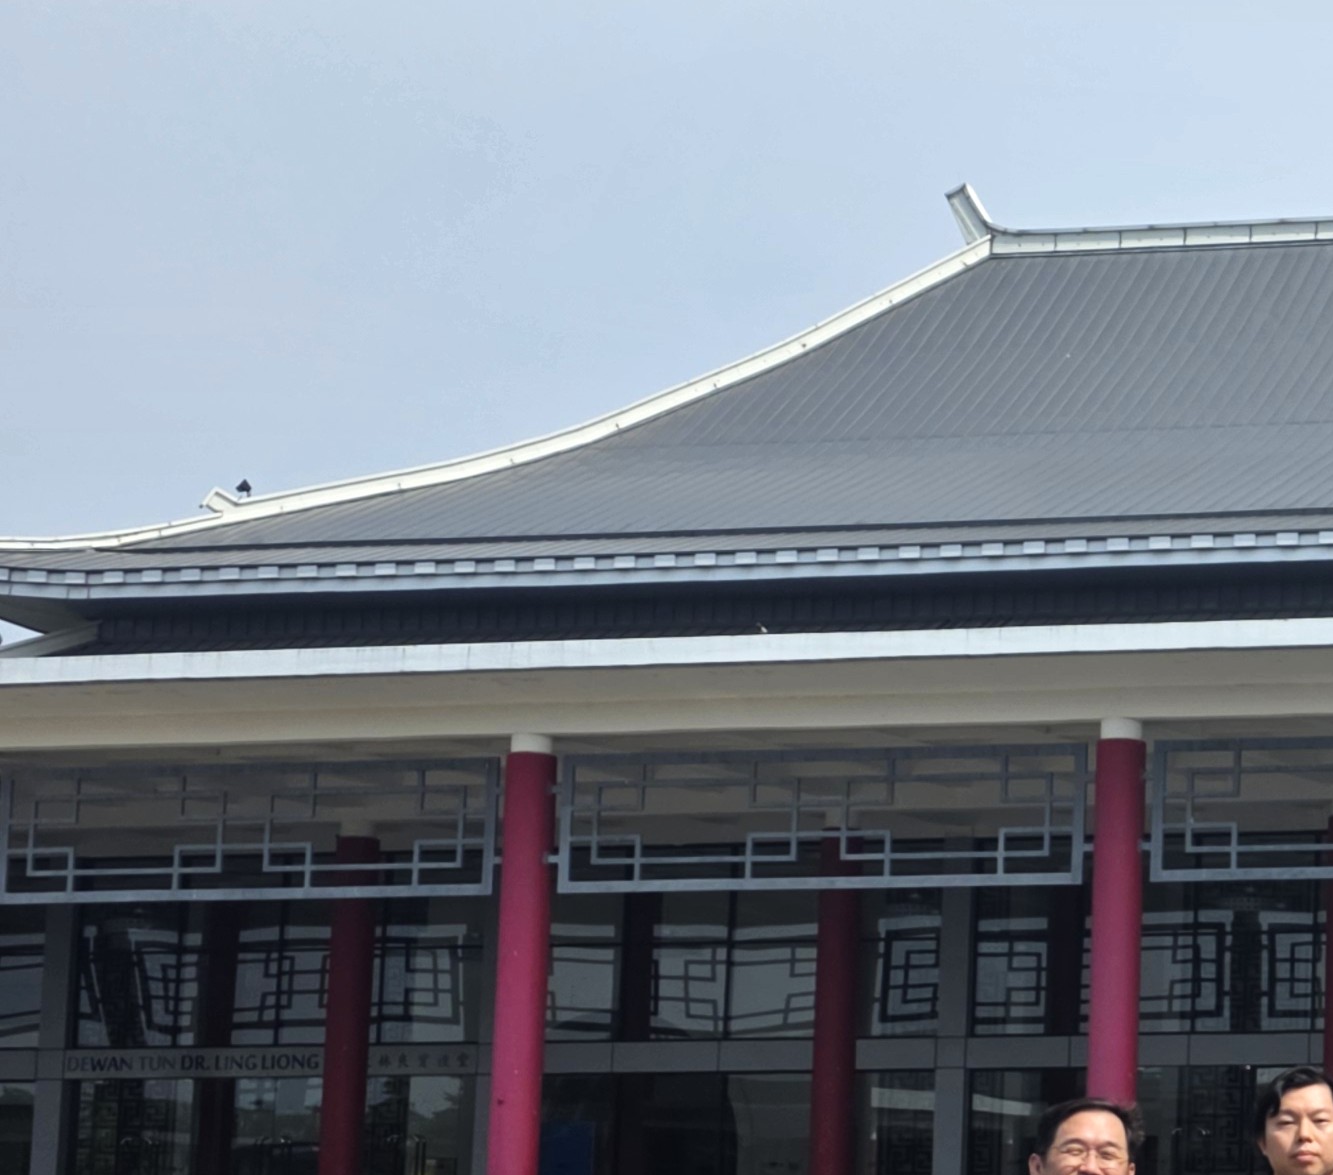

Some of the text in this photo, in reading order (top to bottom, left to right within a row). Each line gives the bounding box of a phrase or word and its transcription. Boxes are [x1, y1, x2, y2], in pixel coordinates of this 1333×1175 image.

[66, 1052, 319, 1073] DEWAN TUN DR. LING LIONG
